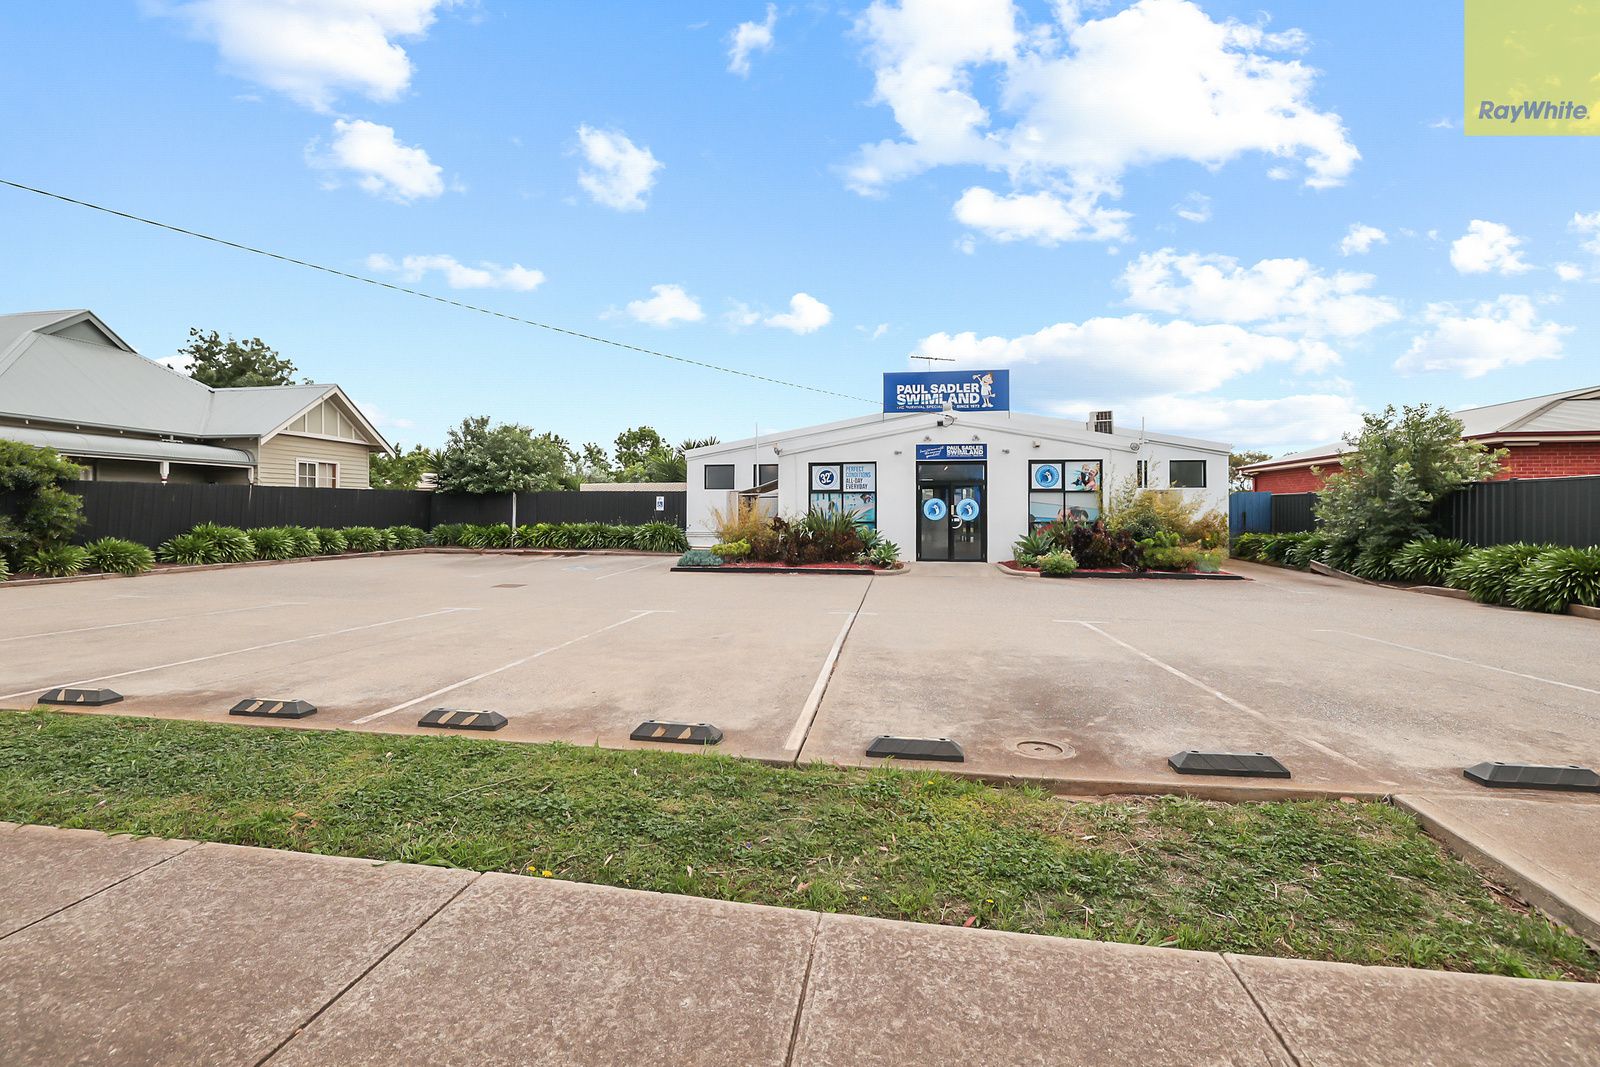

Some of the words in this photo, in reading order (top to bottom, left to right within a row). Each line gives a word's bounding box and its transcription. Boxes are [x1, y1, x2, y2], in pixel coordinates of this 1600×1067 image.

[896, 384, 928, 394] PAUL
[930, 383, 980, 393] SADLER
[896, 393, 980, 405] SWIMLAND
